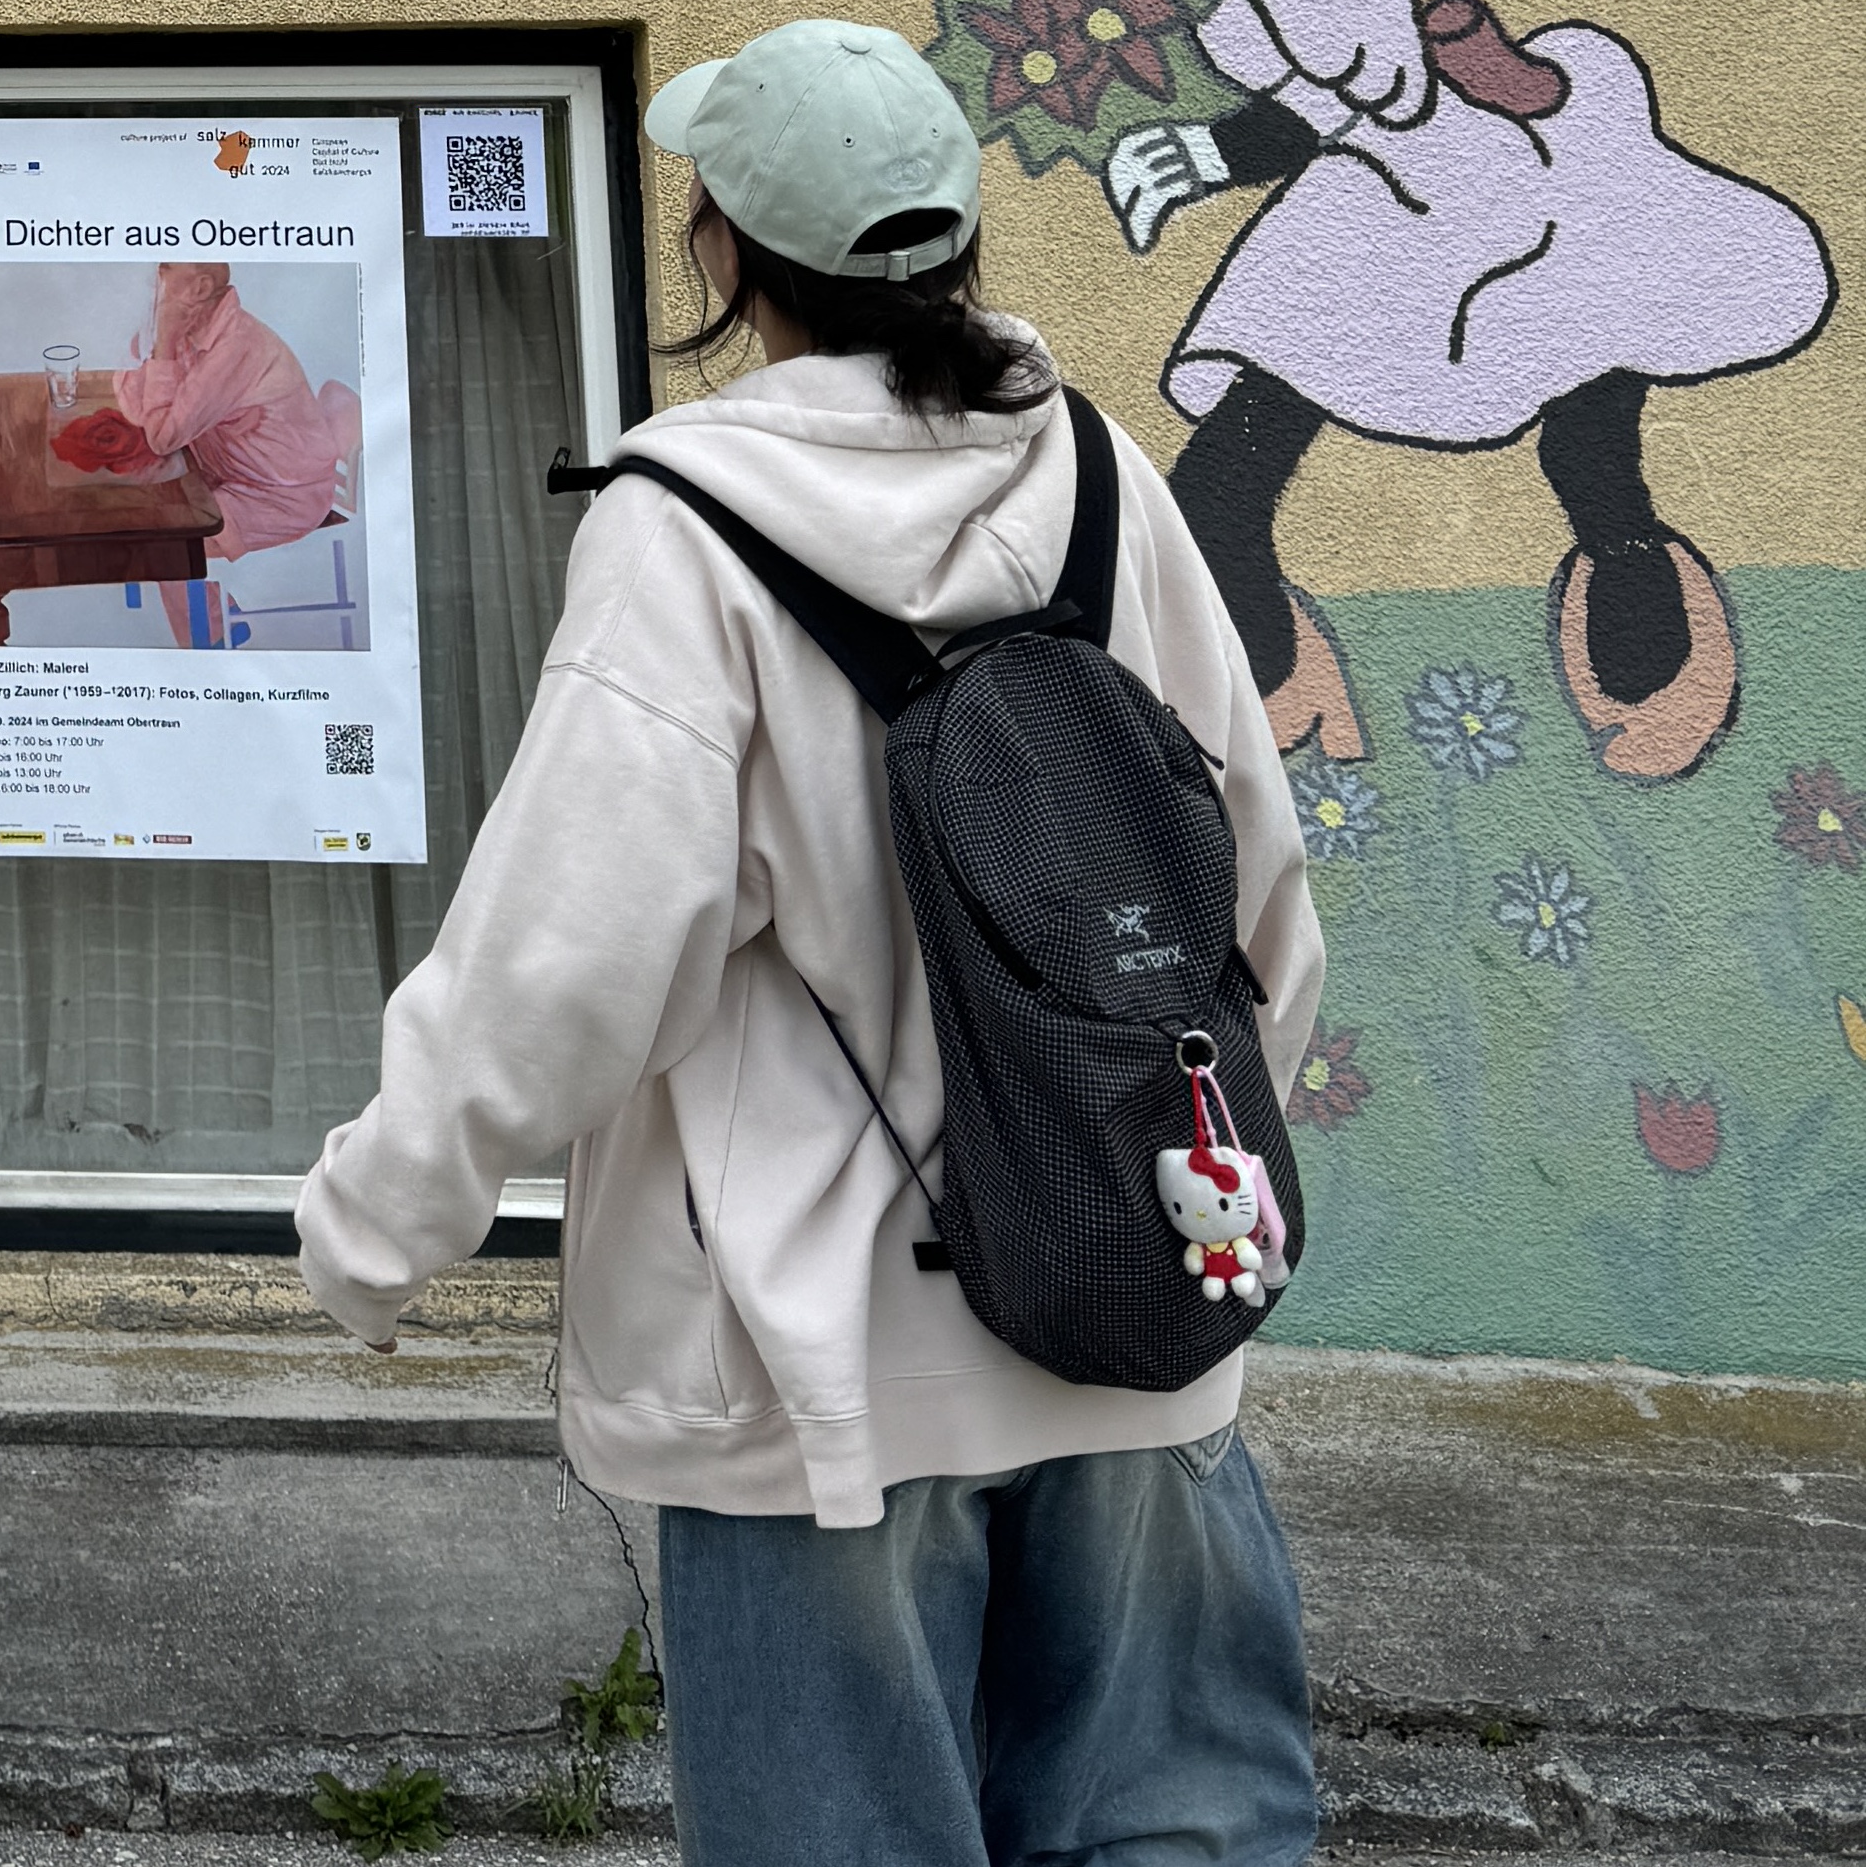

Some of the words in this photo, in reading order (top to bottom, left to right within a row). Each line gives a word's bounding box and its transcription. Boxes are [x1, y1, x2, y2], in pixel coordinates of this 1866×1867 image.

[197, 127, 227, 142] salz
[239, 134, 300, 148] kammer
[229, 163, 255, 179] gut
[261, 165, 290, 176] 2024
[5, 219, 116, 246] Dichter
[124, 226, 181, 246] aus
[191, 219, 355, 246] Obertraun
[43, 662, 89, 674] Malerei
[14, 685, 59, 698] Zauner
[159, 687, 200, 701] Fotos,
[203, 688, 265, 703] Collagen,
[268, 689, 330, 701] Kurzfilme
[8, 716, 32, 727] 2024
[36, 717, 49, 727] im
[51, 716, 124, 728] Gemeindeamt
[127, 717, 181, 729] Obertraun
[38, 736, 53, 747] bis
[86, 736, 105, 747] Uhr
[45, 752, 63, 763] Uhr
[44, 768, 62, 778] Uhr
[25, 783, 40, 794] bis
[73, 784, 91, 794] Uhr
